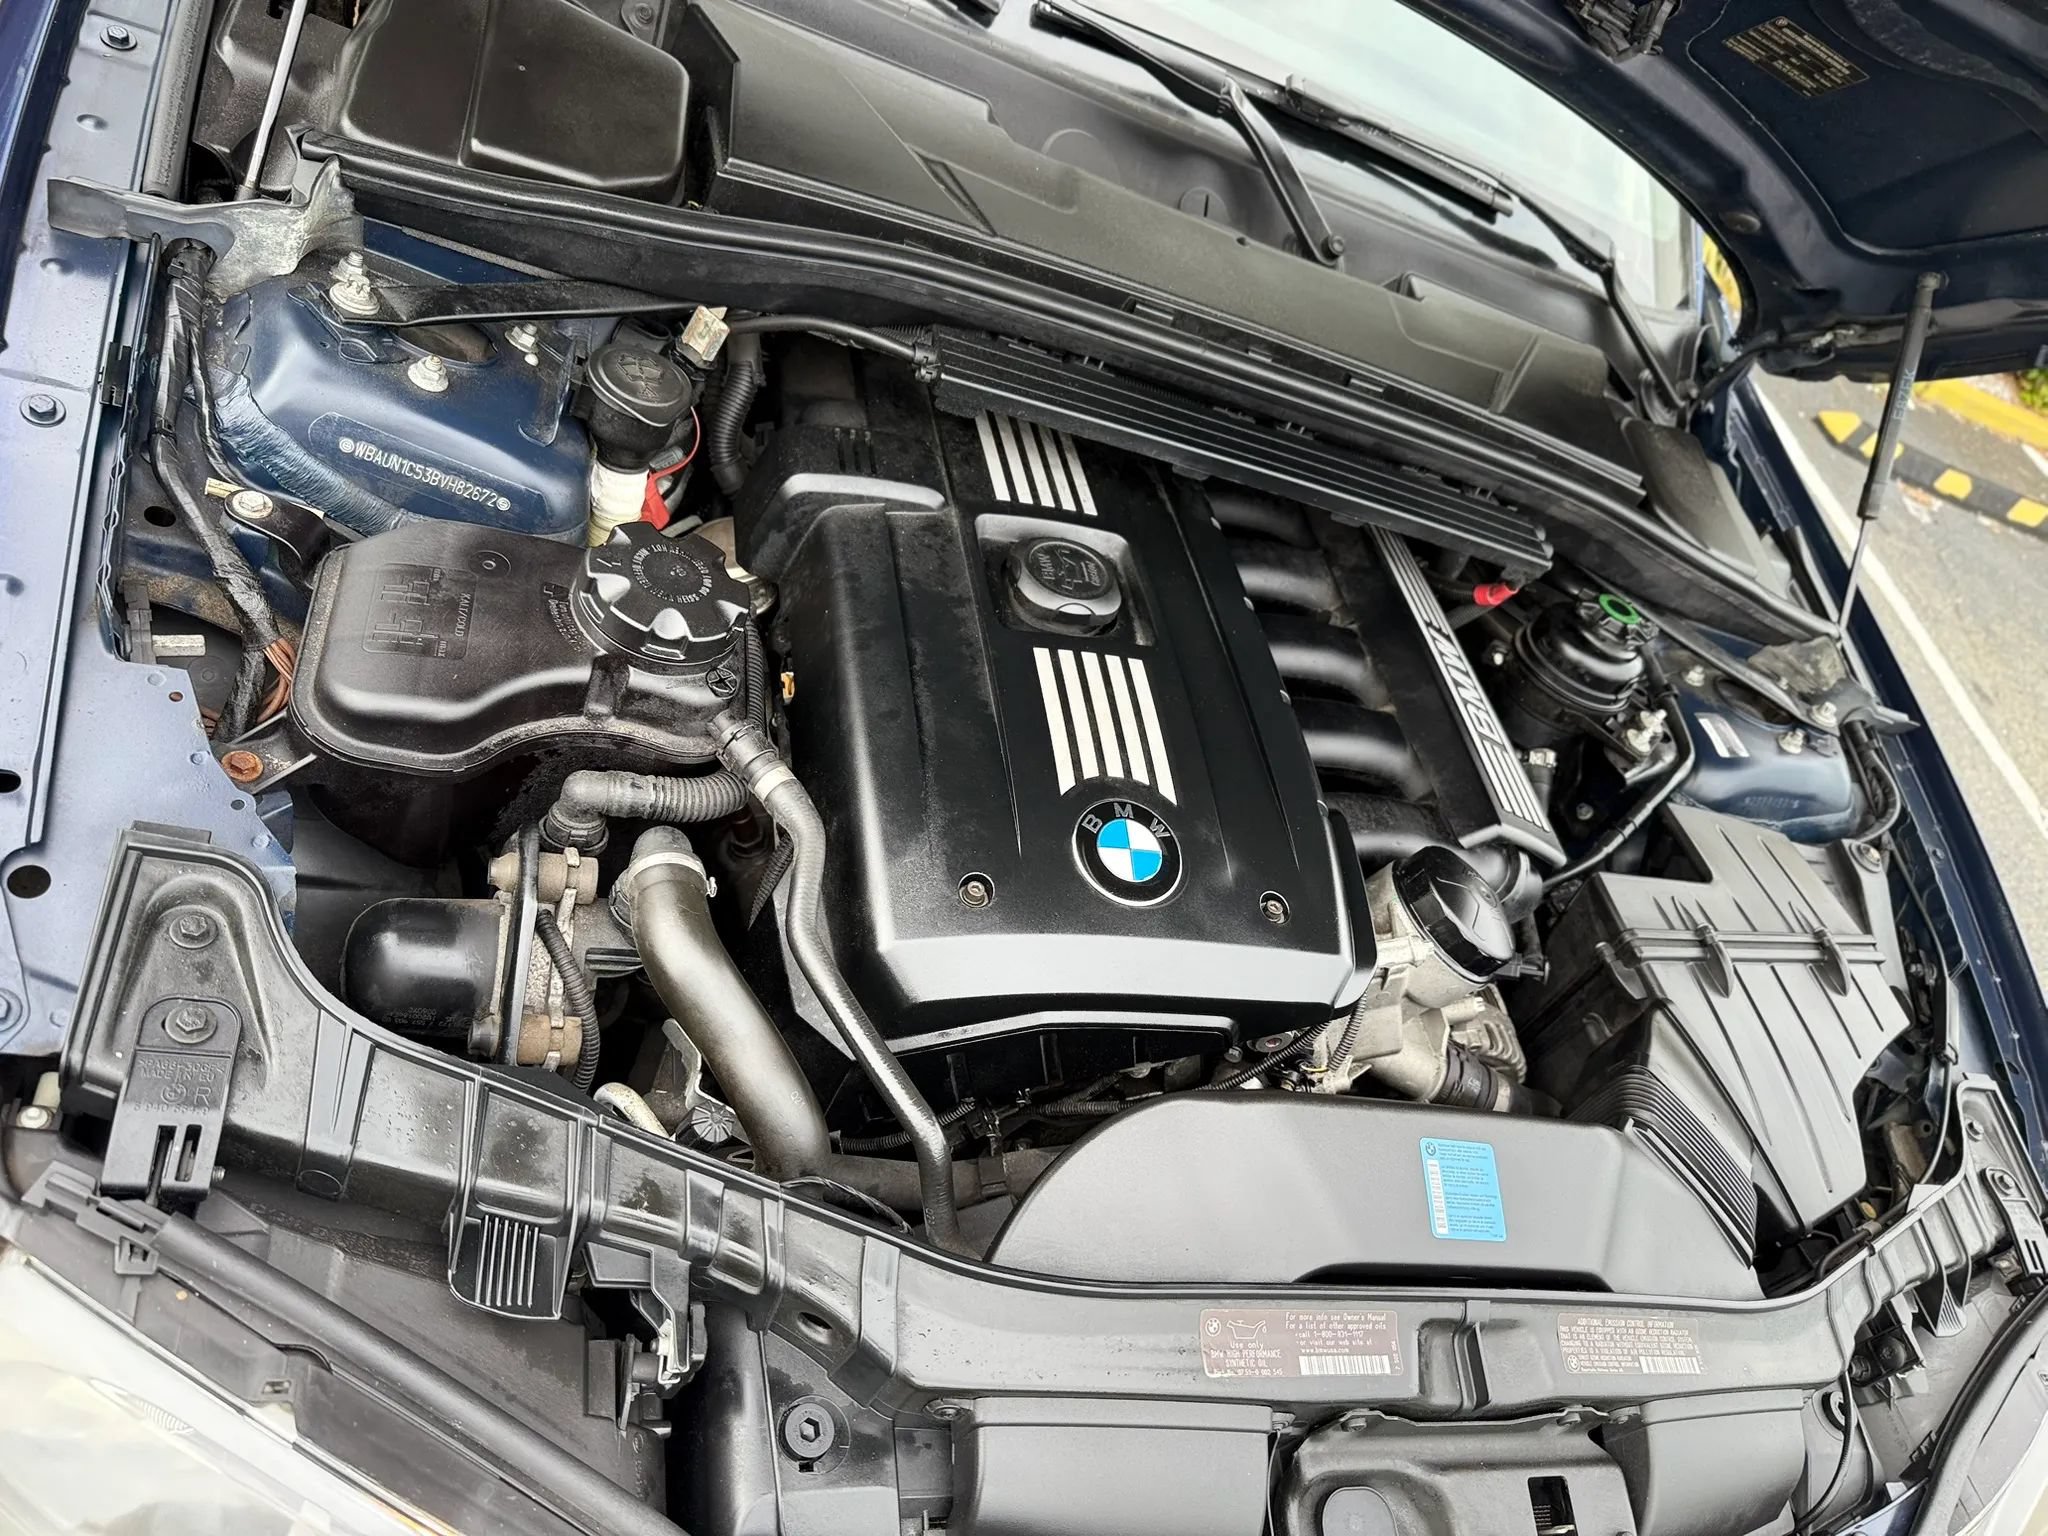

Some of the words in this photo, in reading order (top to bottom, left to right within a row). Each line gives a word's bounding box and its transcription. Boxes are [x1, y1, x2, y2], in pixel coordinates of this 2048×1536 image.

[354, 441, 498, 508] WBAUN1C53BVH82672
[1038, 552, 1056, 581] BMW
[454, 592, 472, 637] KALT/COLD
[1427, 625, 1503, 746] BMW
[1081, 802, 1171, 838] BMW
[140, 1067, 174, 1080] MADE
[198, 1072, 215, 1083] EU
[194, 1086, 212, 1108] R
[1286, 1312, 1296, 1321] For
[1368, 1313, 1386, 1321] Manual
[1286, 1321, 1296, 1330] For
[1306, 1322, 1317, 1330] list
[1329, 1322, 1344, 1330] other
[1347, 1322, 1373, 1332] approved
[1230, 1341, 1244, 1349] Use
[1247, 1340, 1264, 1351] only
[1242, 1349, 1282, 1358] PERFORMANCE
[1225, 1358, 1256, 1368] SYNTHETIC
